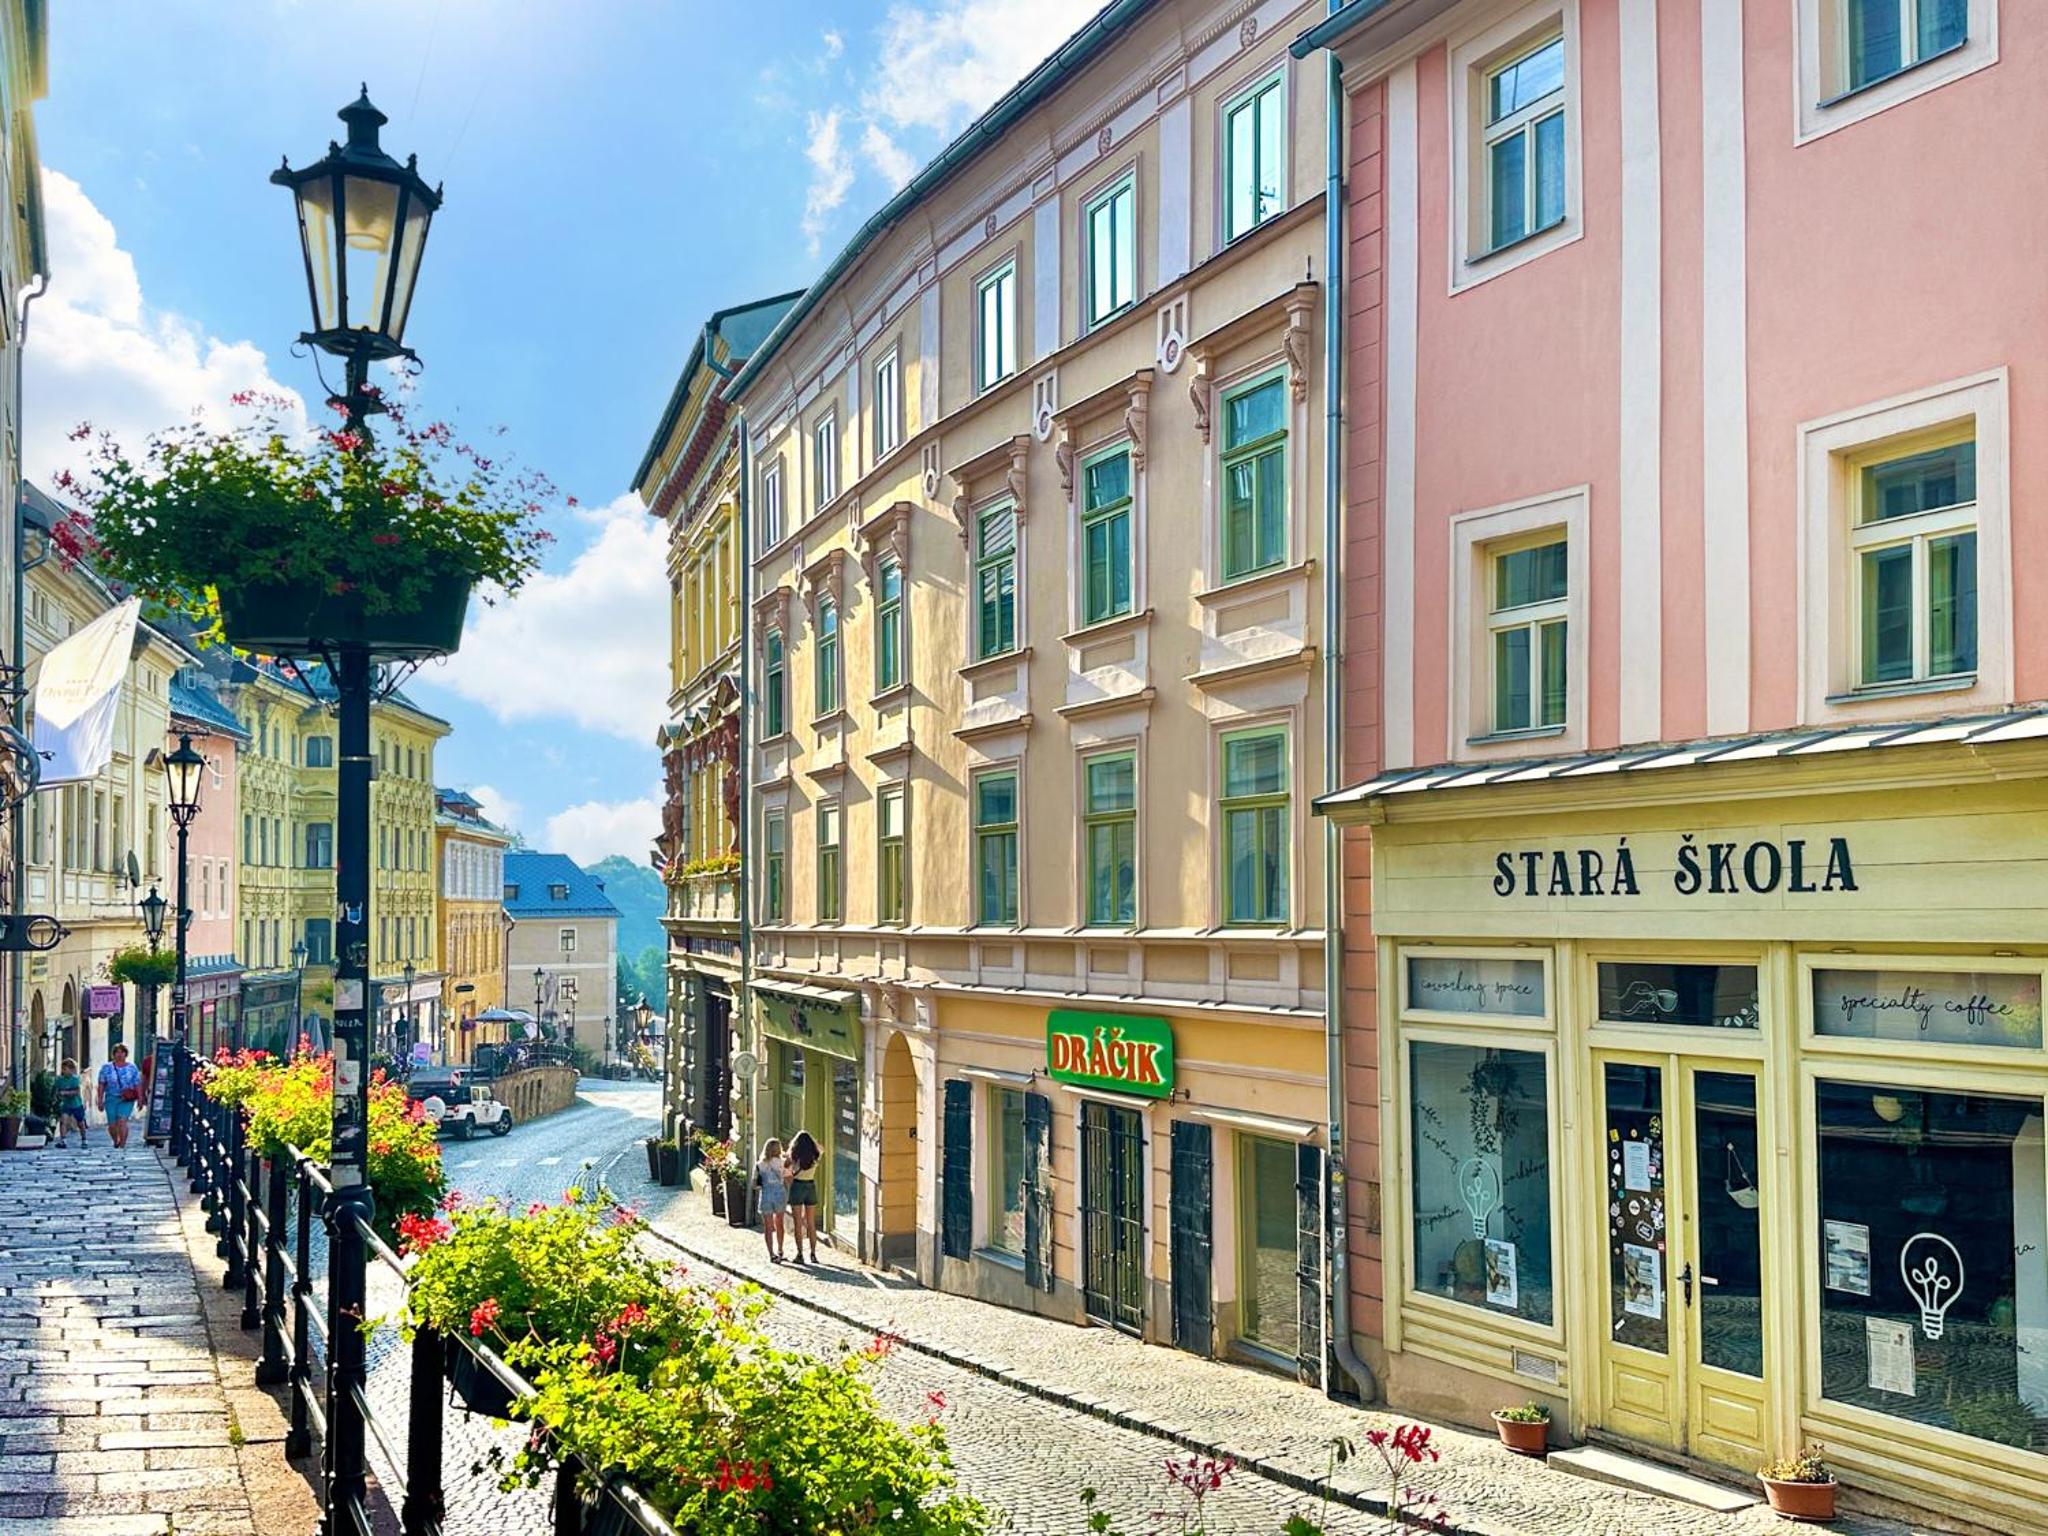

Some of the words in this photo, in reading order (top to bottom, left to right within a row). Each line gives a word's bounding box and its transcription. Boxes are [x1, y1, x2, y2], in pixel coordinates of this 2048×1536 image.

[1493, 837, 1640, 897] STARÁ
[1674, 834, 1858, 895] ŠKOLA
[1421, 970, 1487, 1007] coworking
[1495, 981, 1532, 1003] space
[1841, 986, 1934, 1030] specialty
[1945, 995, 2014, 1026] coffee
[1051, 1026, 1166, 1085] DRÁČIK
